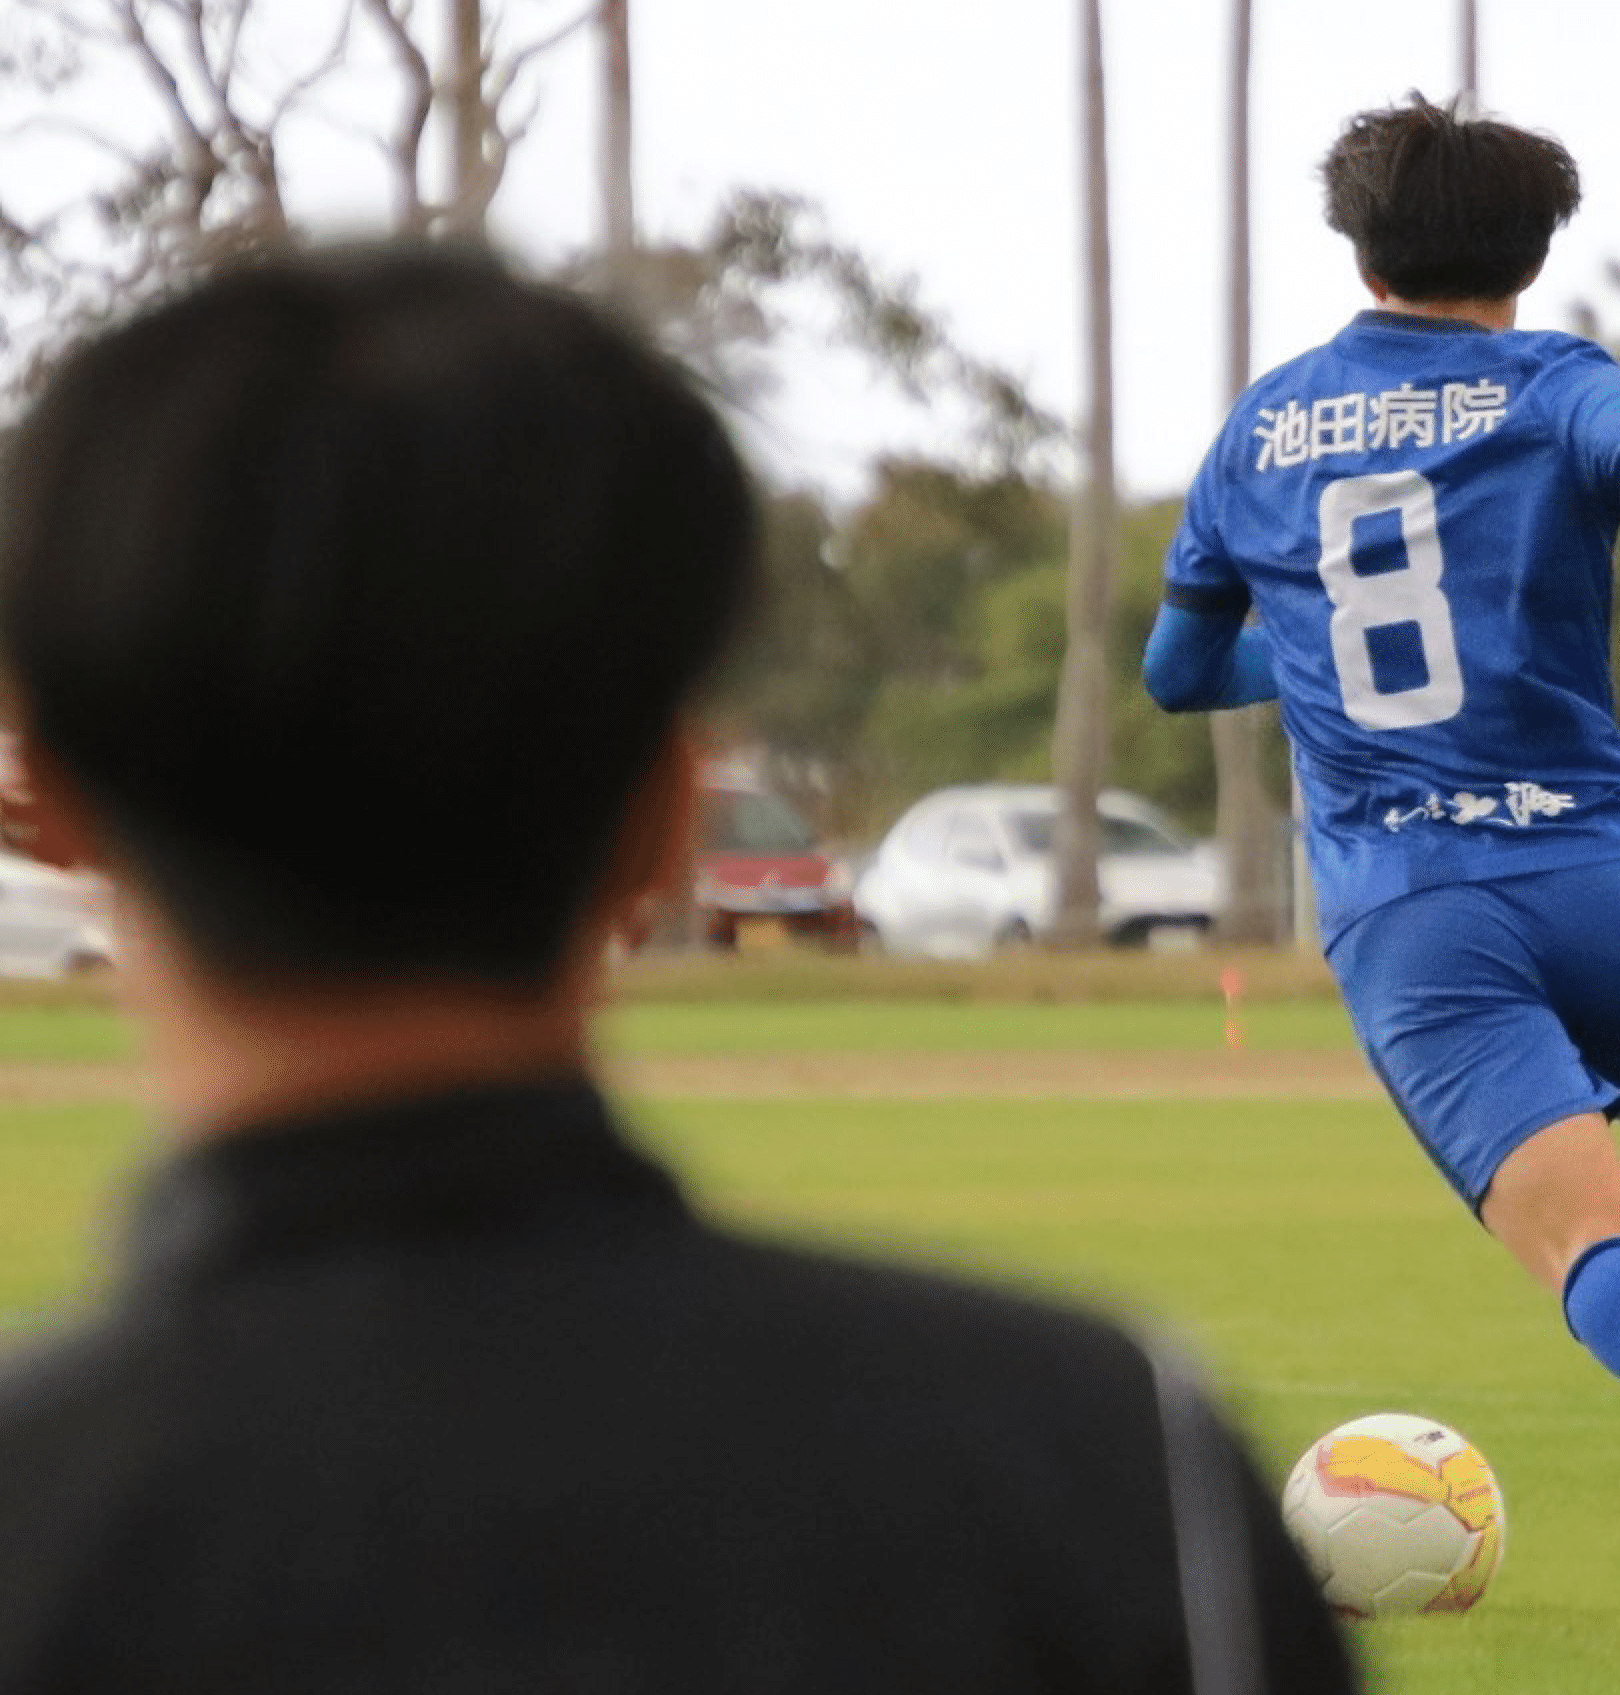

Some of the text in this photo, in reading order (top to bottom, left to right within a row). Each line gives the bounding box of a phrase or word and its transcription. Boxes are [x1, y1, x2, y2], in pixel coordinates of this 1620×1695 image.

[1254, 378, 1506, 472] 池田病院
[1318, 469, 1464, 730] 8
